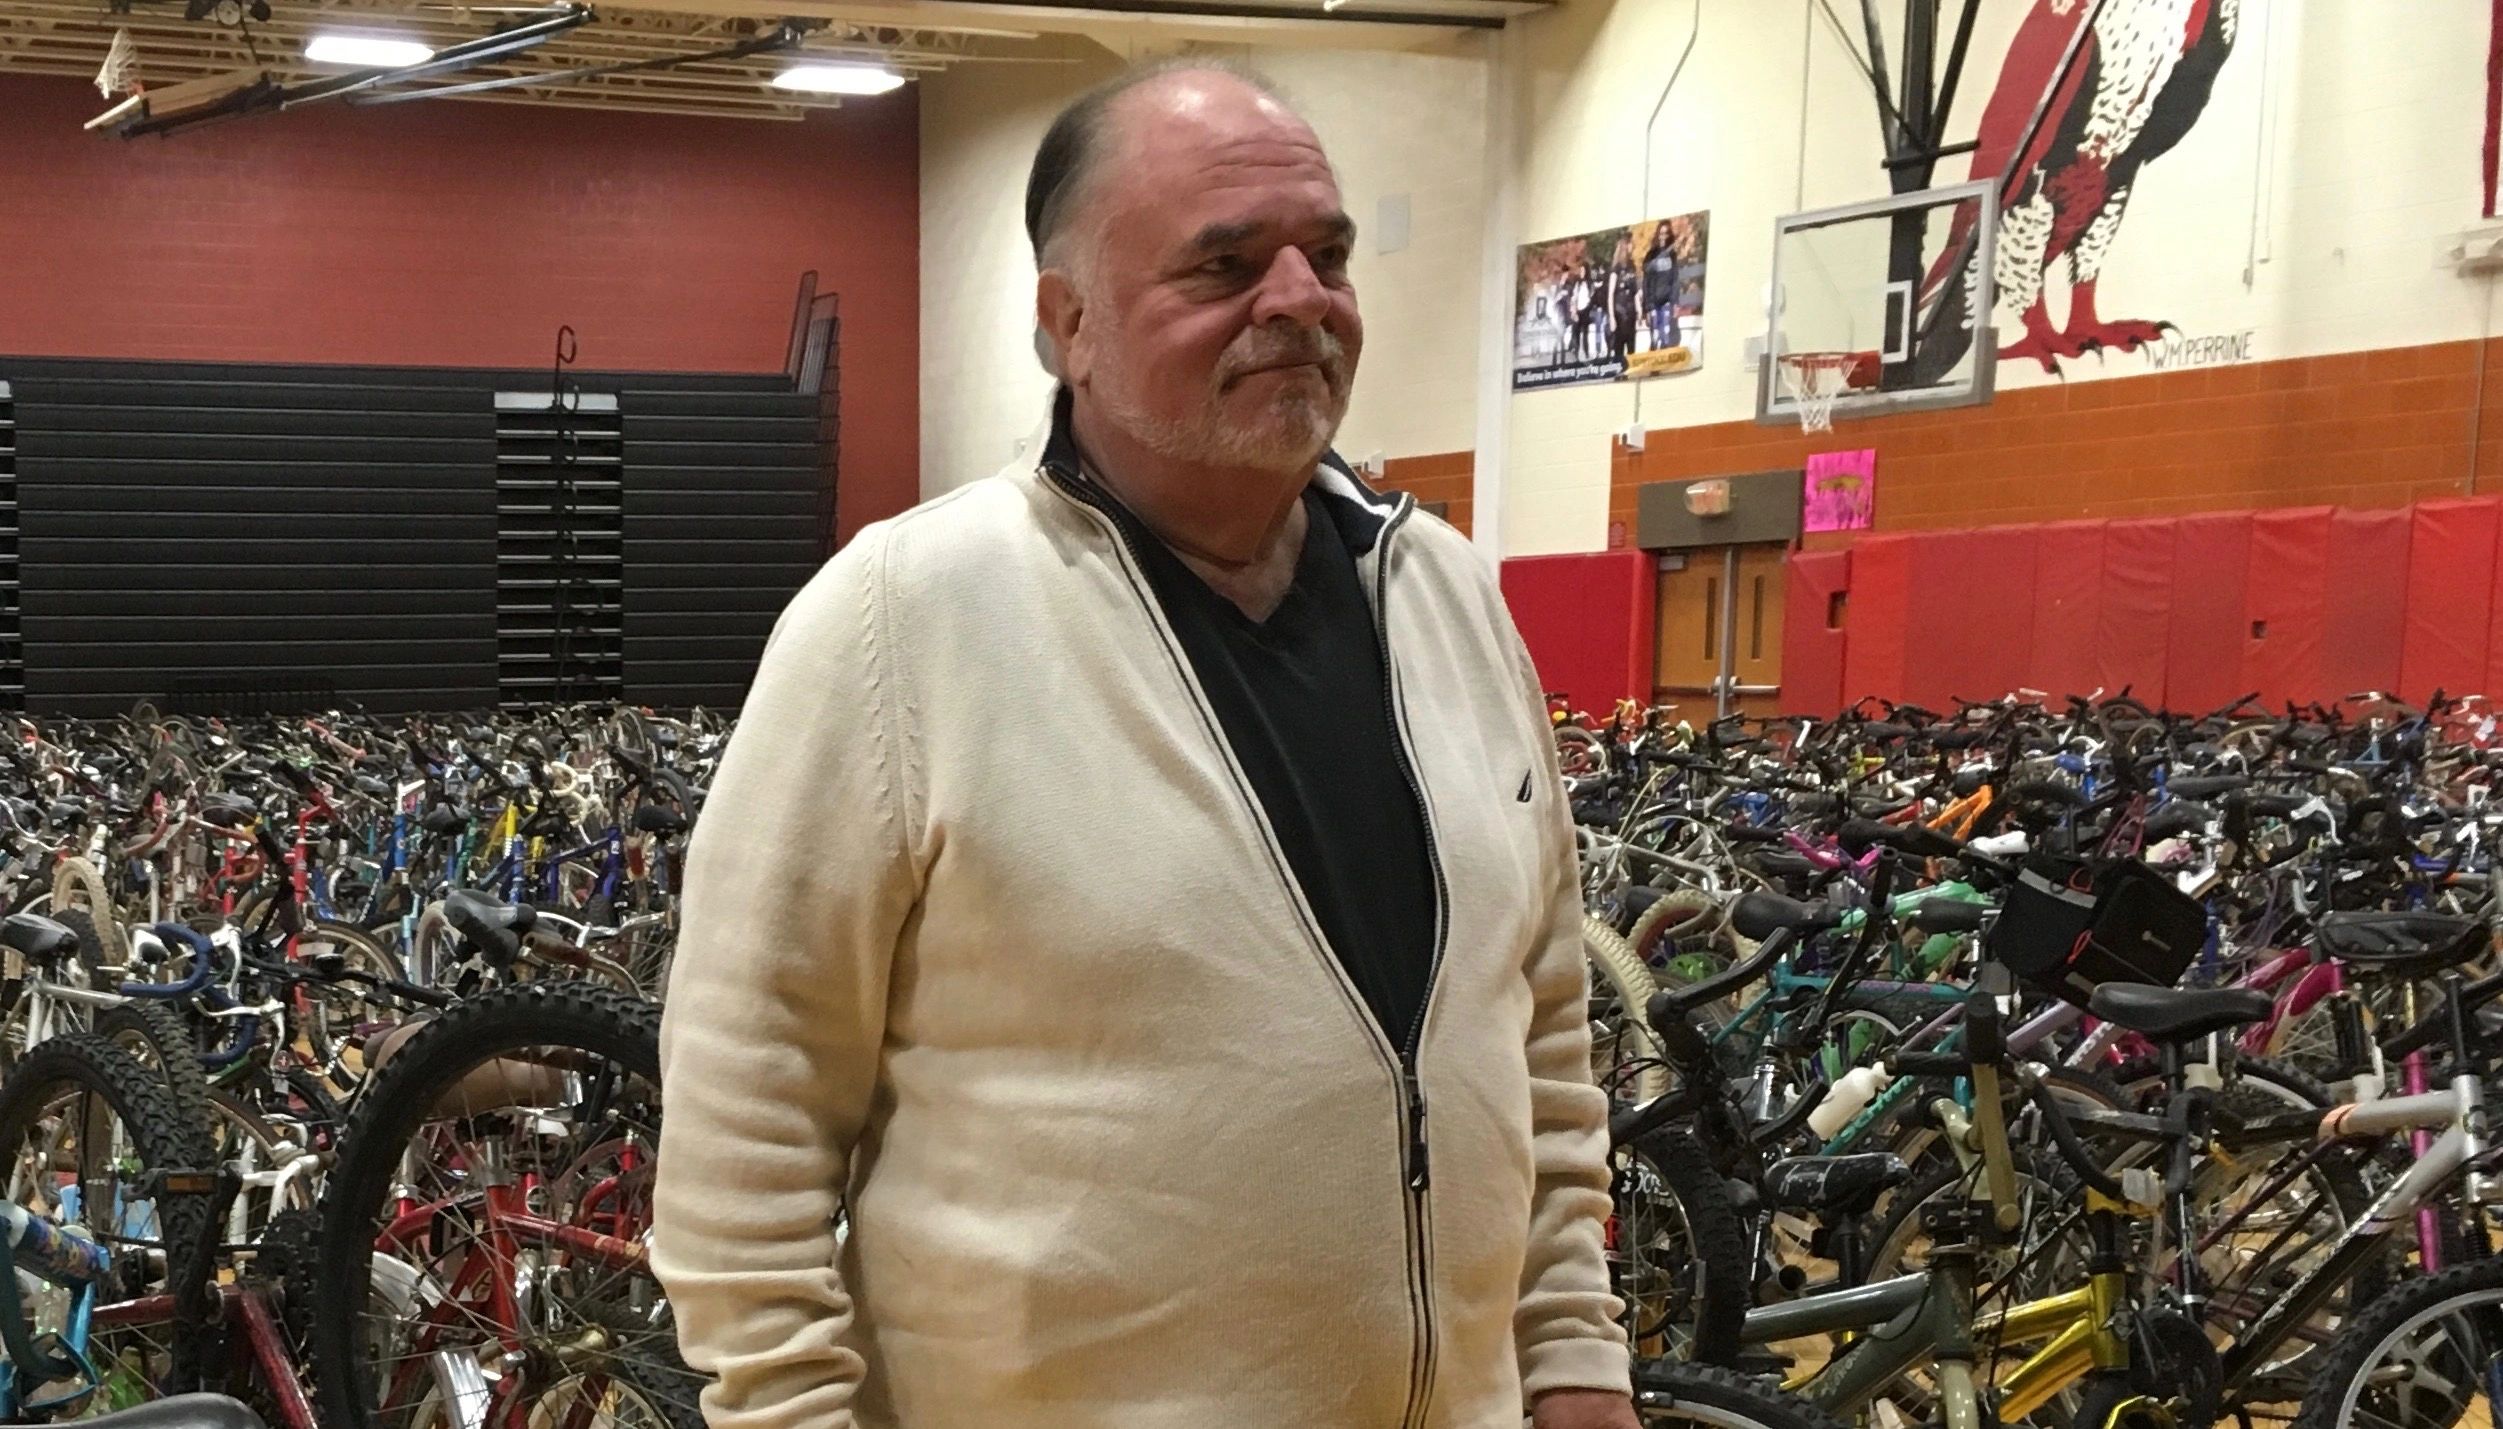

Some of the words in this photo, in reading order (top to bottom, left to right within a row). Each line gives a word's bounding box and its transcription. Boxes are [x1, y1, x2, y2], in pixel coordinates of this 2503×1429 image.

[1517, 371, 1544, 383] Believe
[1544, 369, 1552, 379] in
[1553, 367, 1575, 378] where
[1576, 364, 1599, 379] you're
